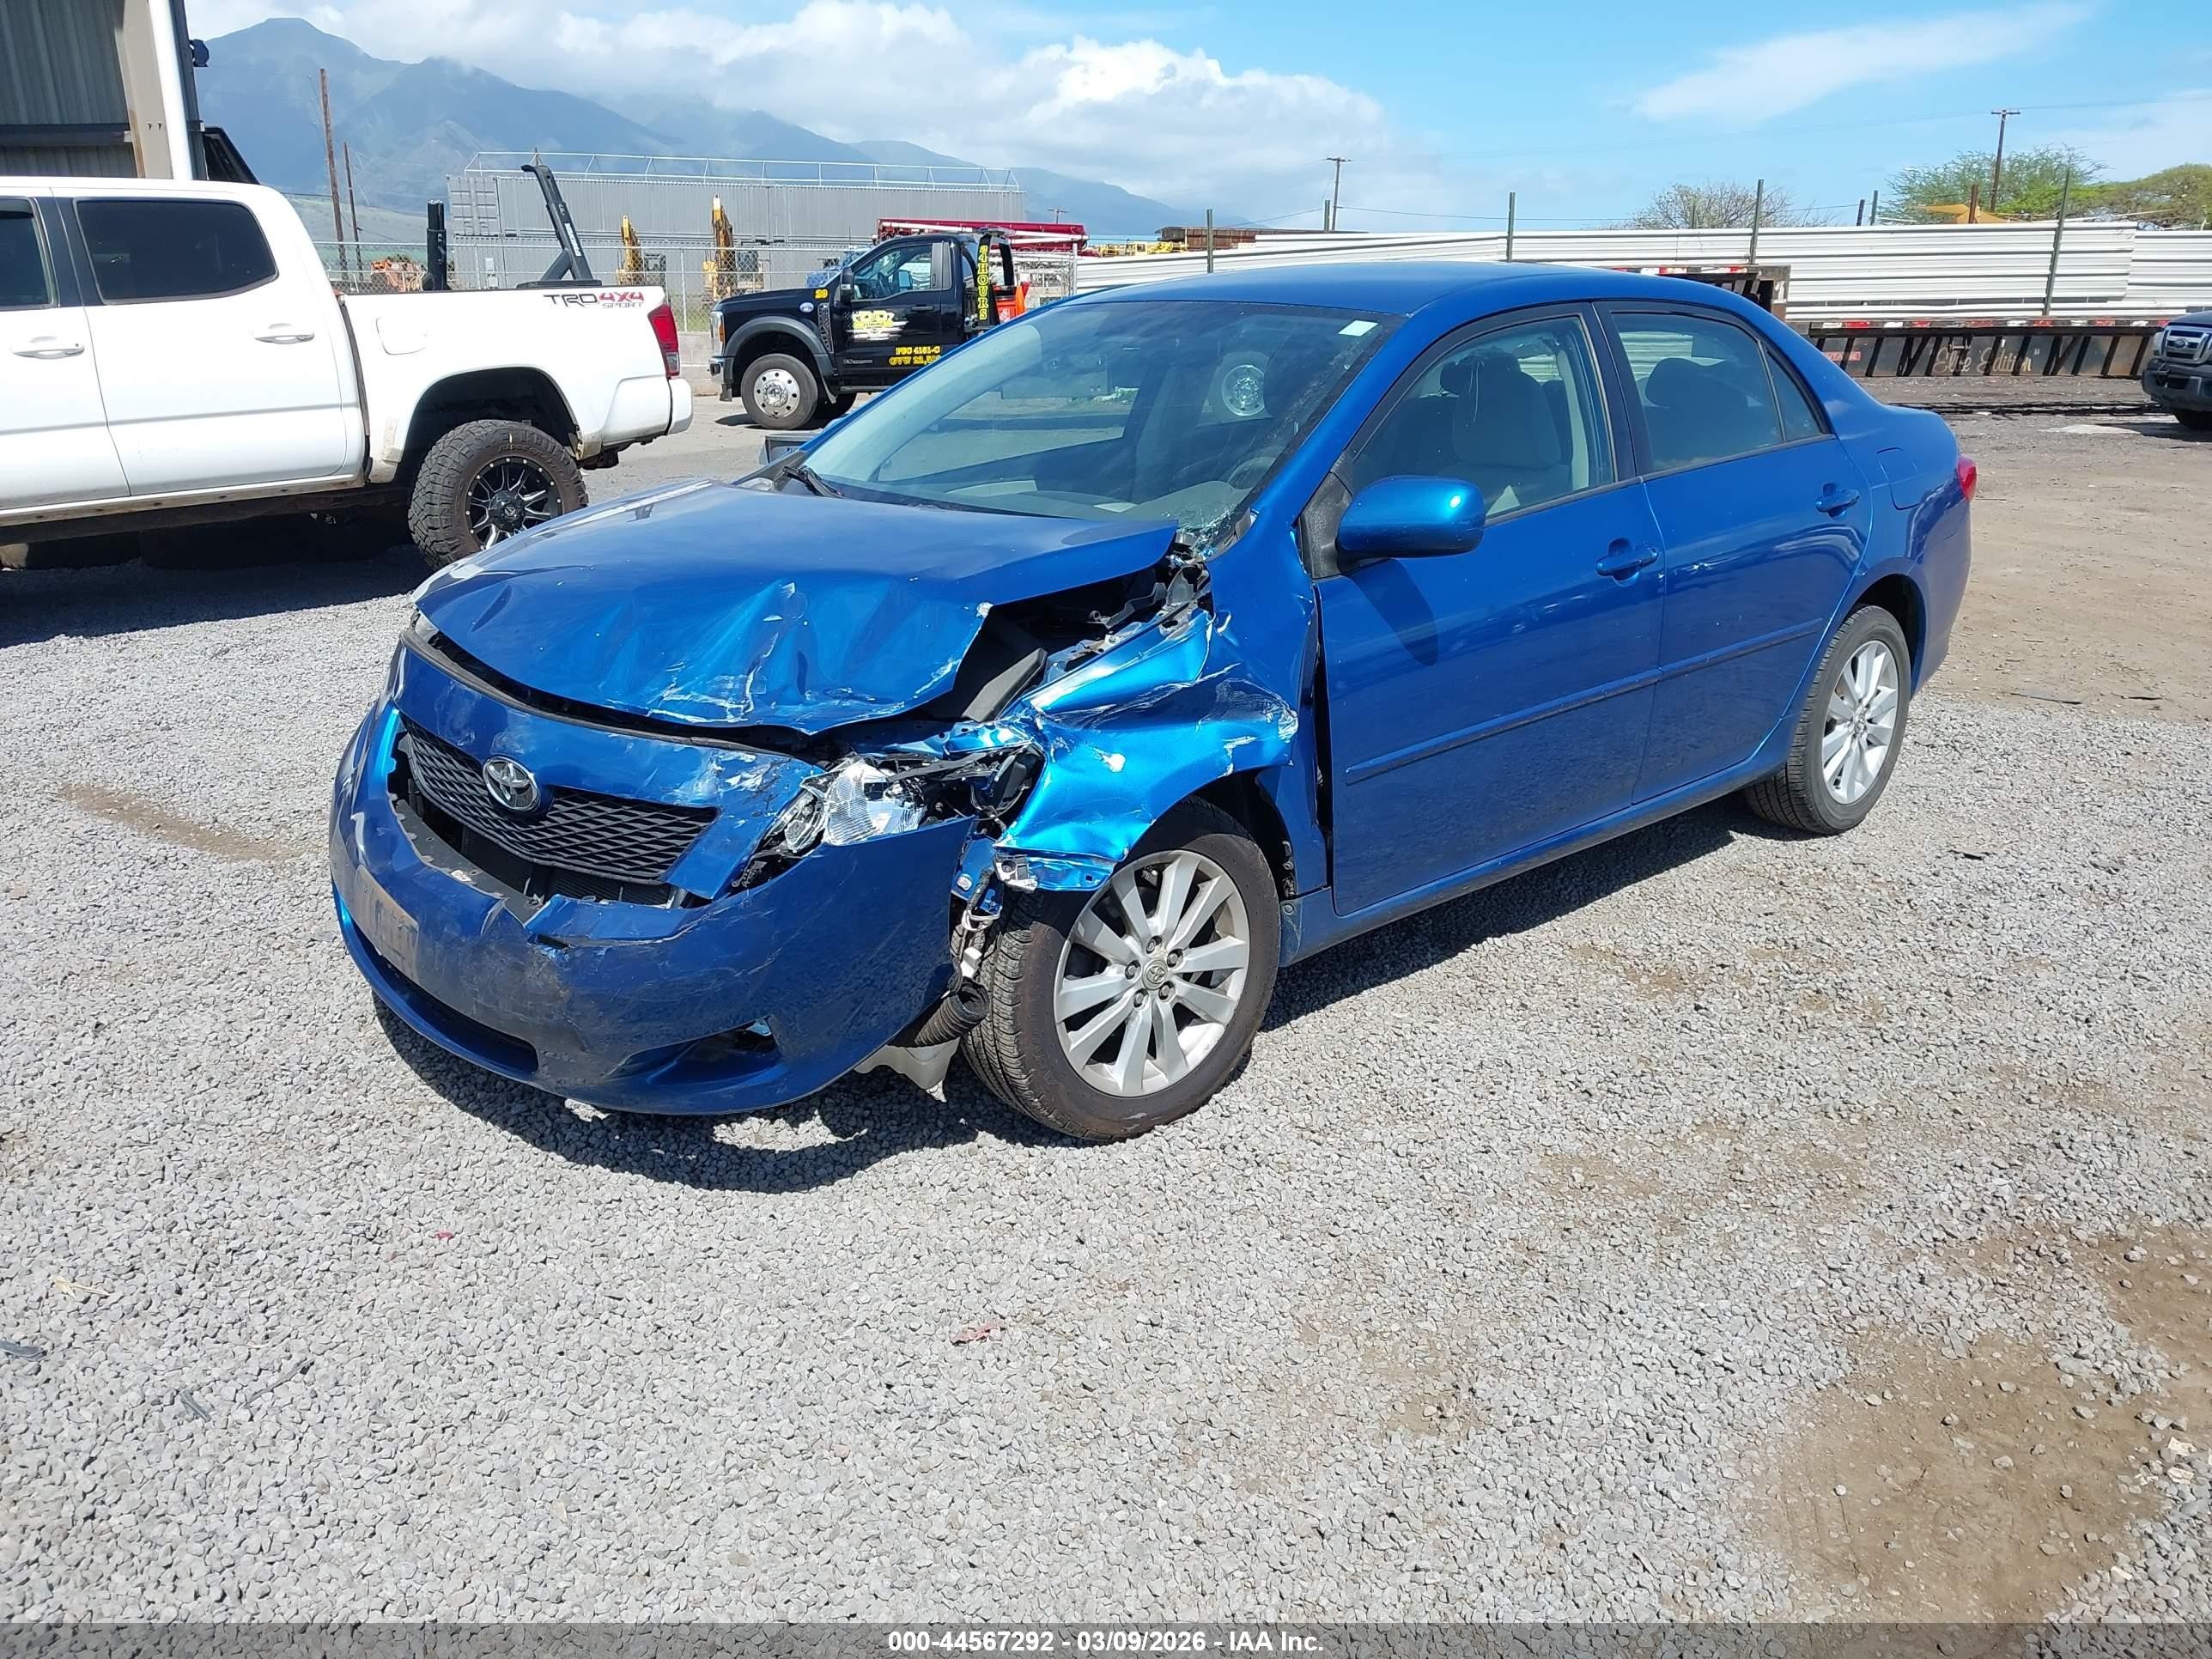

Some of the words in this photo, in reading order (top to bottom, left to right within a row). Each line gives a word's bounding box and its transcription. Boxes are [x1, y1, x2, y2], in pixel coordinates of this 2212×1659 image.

[543, 293, 599, 307] TRD
[977, 263, 989, 320] HOURS
[889, 356, 912, 365] GVW
[1977, 347, 2033, 374] Editin
